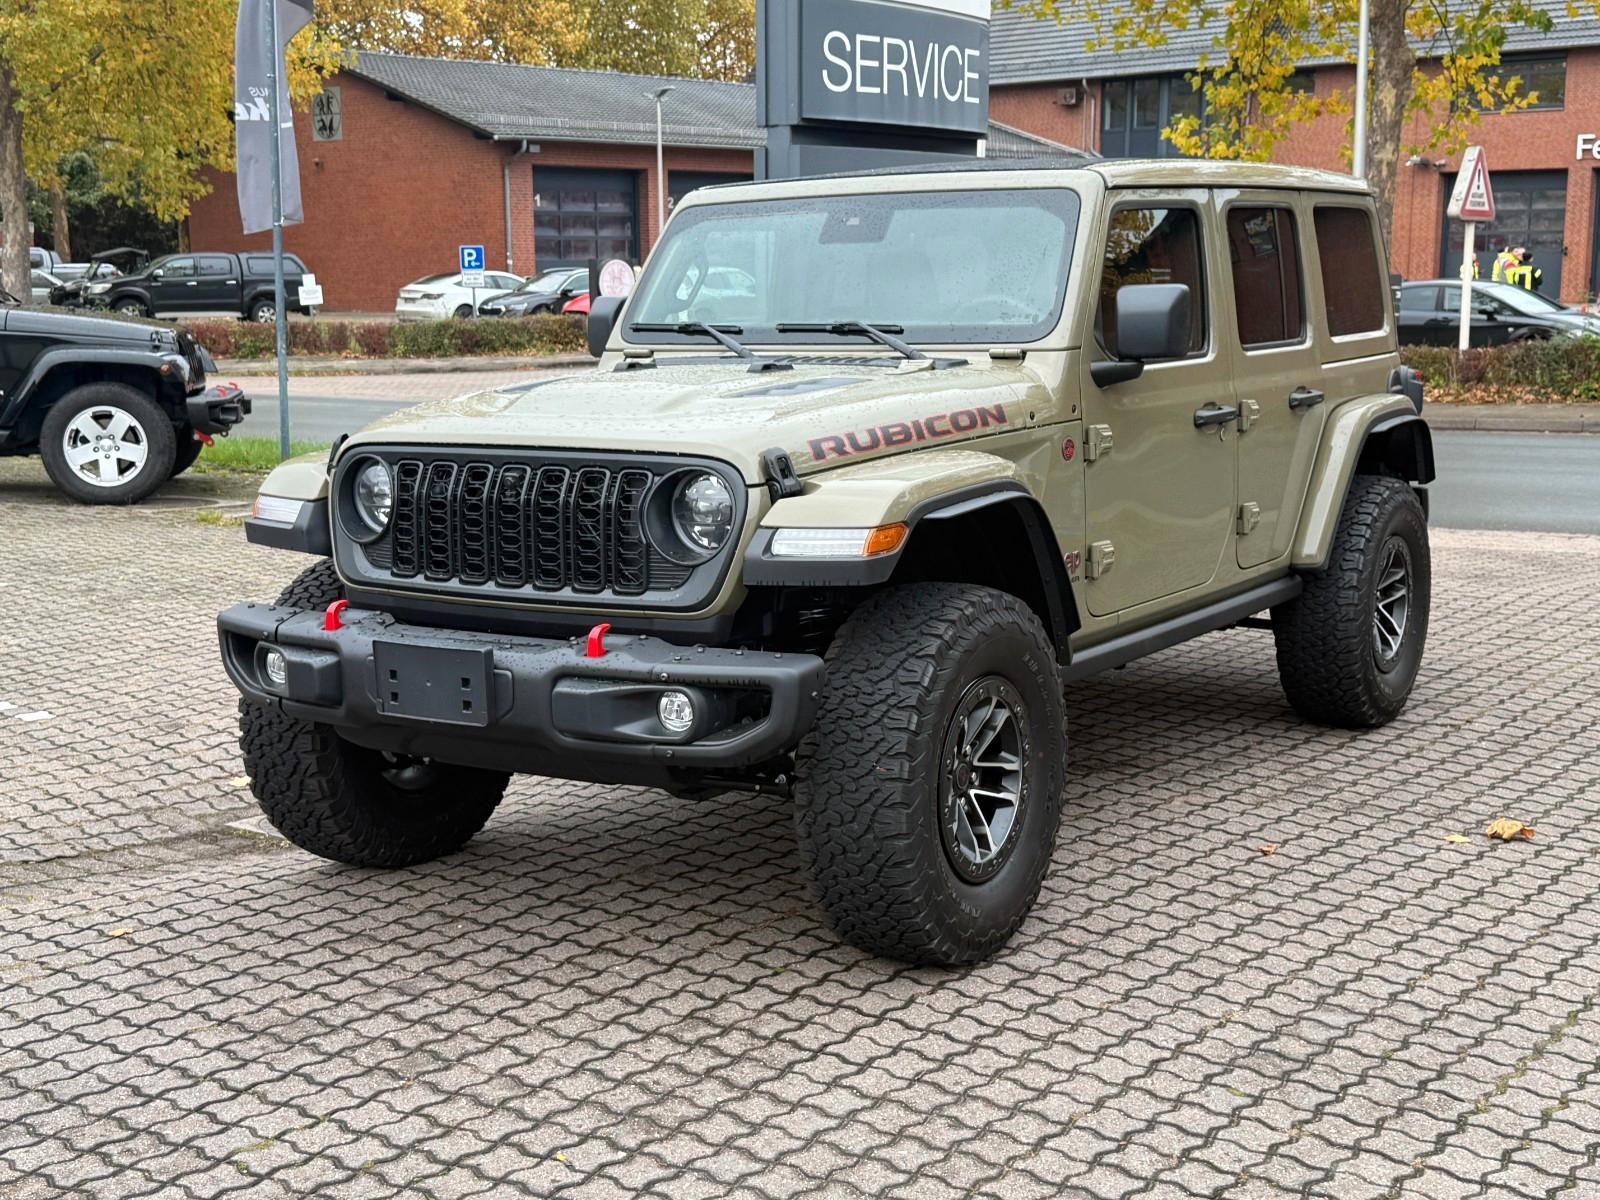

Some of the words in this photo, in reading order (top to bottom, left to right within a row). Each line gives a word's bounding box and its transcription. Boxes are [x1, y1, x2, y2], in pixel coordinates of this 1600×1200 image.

[822, 30, 980, 104] SERVICE
[534, 193, 541, 207] 1
[667, 196, 674, 209] 2
[464, 248, 477, 267] P
[806, 403, 1008, 462] RUBICON
